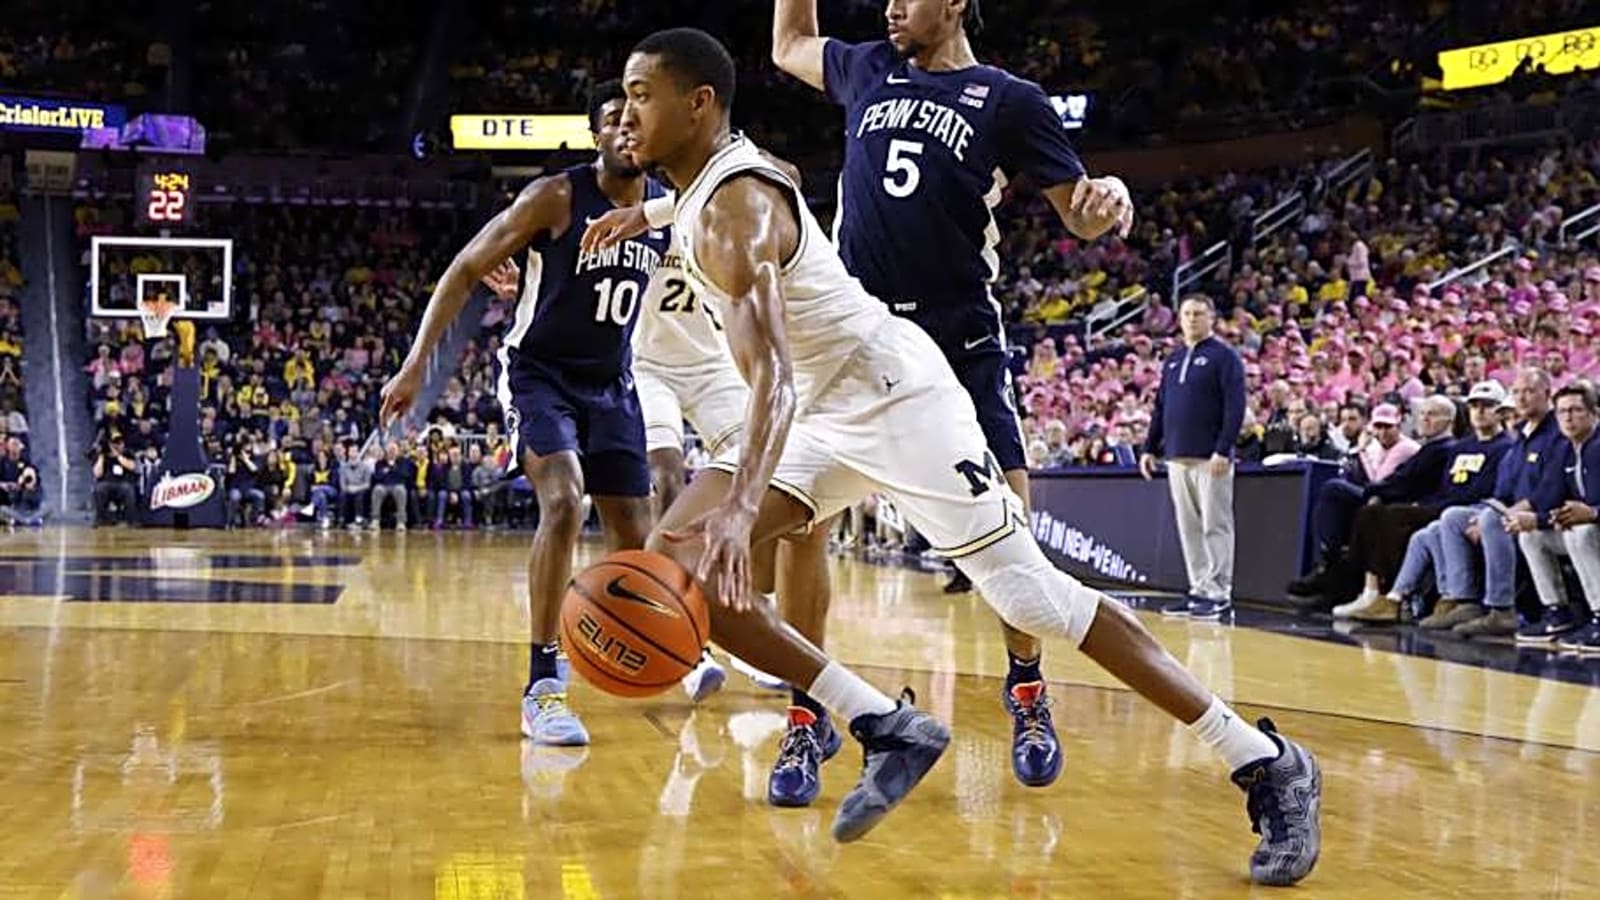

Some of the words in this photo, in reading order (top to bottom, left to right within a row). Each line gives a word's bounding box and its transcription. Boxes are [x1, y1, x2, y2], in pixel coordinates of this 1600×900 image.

[482, 119, 534, 136] DTE
[857, 99, 920, 138] PENN
[912, 99, 974, 162] STATE
[882, 138, 924, 198] 5
[149, 190, 184, 220] 22
[575, 240, 620, 275] PENN
[594, 277, 639, 326] 10
[659, 278, 696, 313] 21
[151, 481, 209, 507] LIBMAN
[954, 451, 1005, 497] M
[577, 612, 648, 672] ELITE
